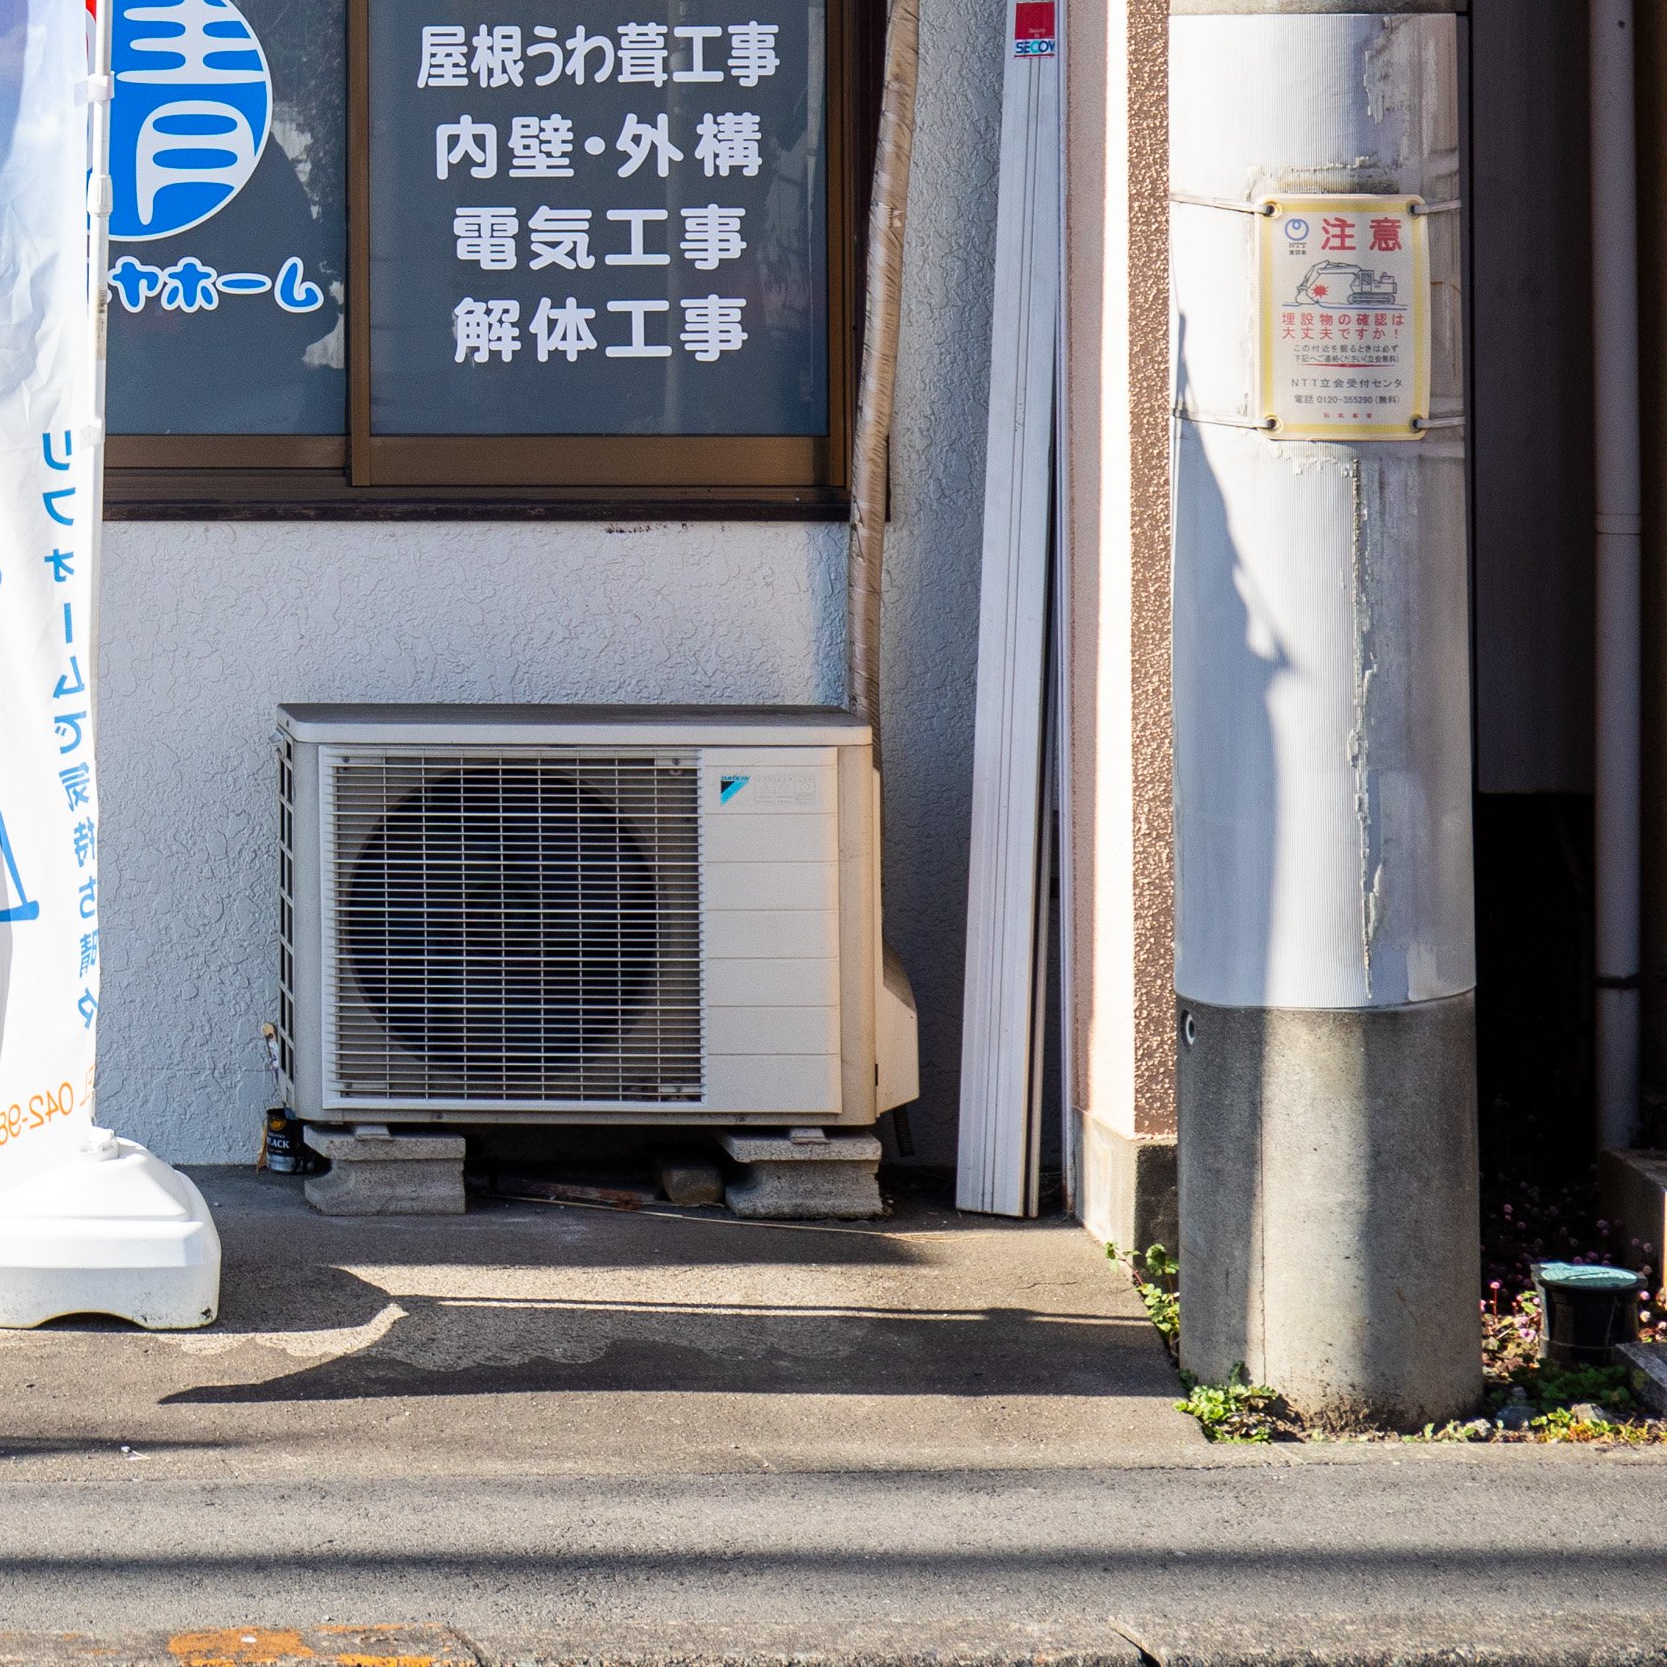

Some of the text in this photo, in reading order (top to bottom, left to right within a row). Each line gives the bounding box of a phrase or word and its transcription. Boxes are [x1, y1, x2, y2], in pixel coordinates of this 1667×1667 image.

[417, 20, 781, 89] 屋根うわ葺工事
[435, 112, 764, 180] 内壁・外構
[453, 203, 748, 271] 電気工事
[1321, 217, 1403, 252] 注意
[108, 256, 326, 313] ヤホーム
[453, 294, 749, 363] 解体工事
[1281, 312, 1405, 326] 埋設物の確認は
